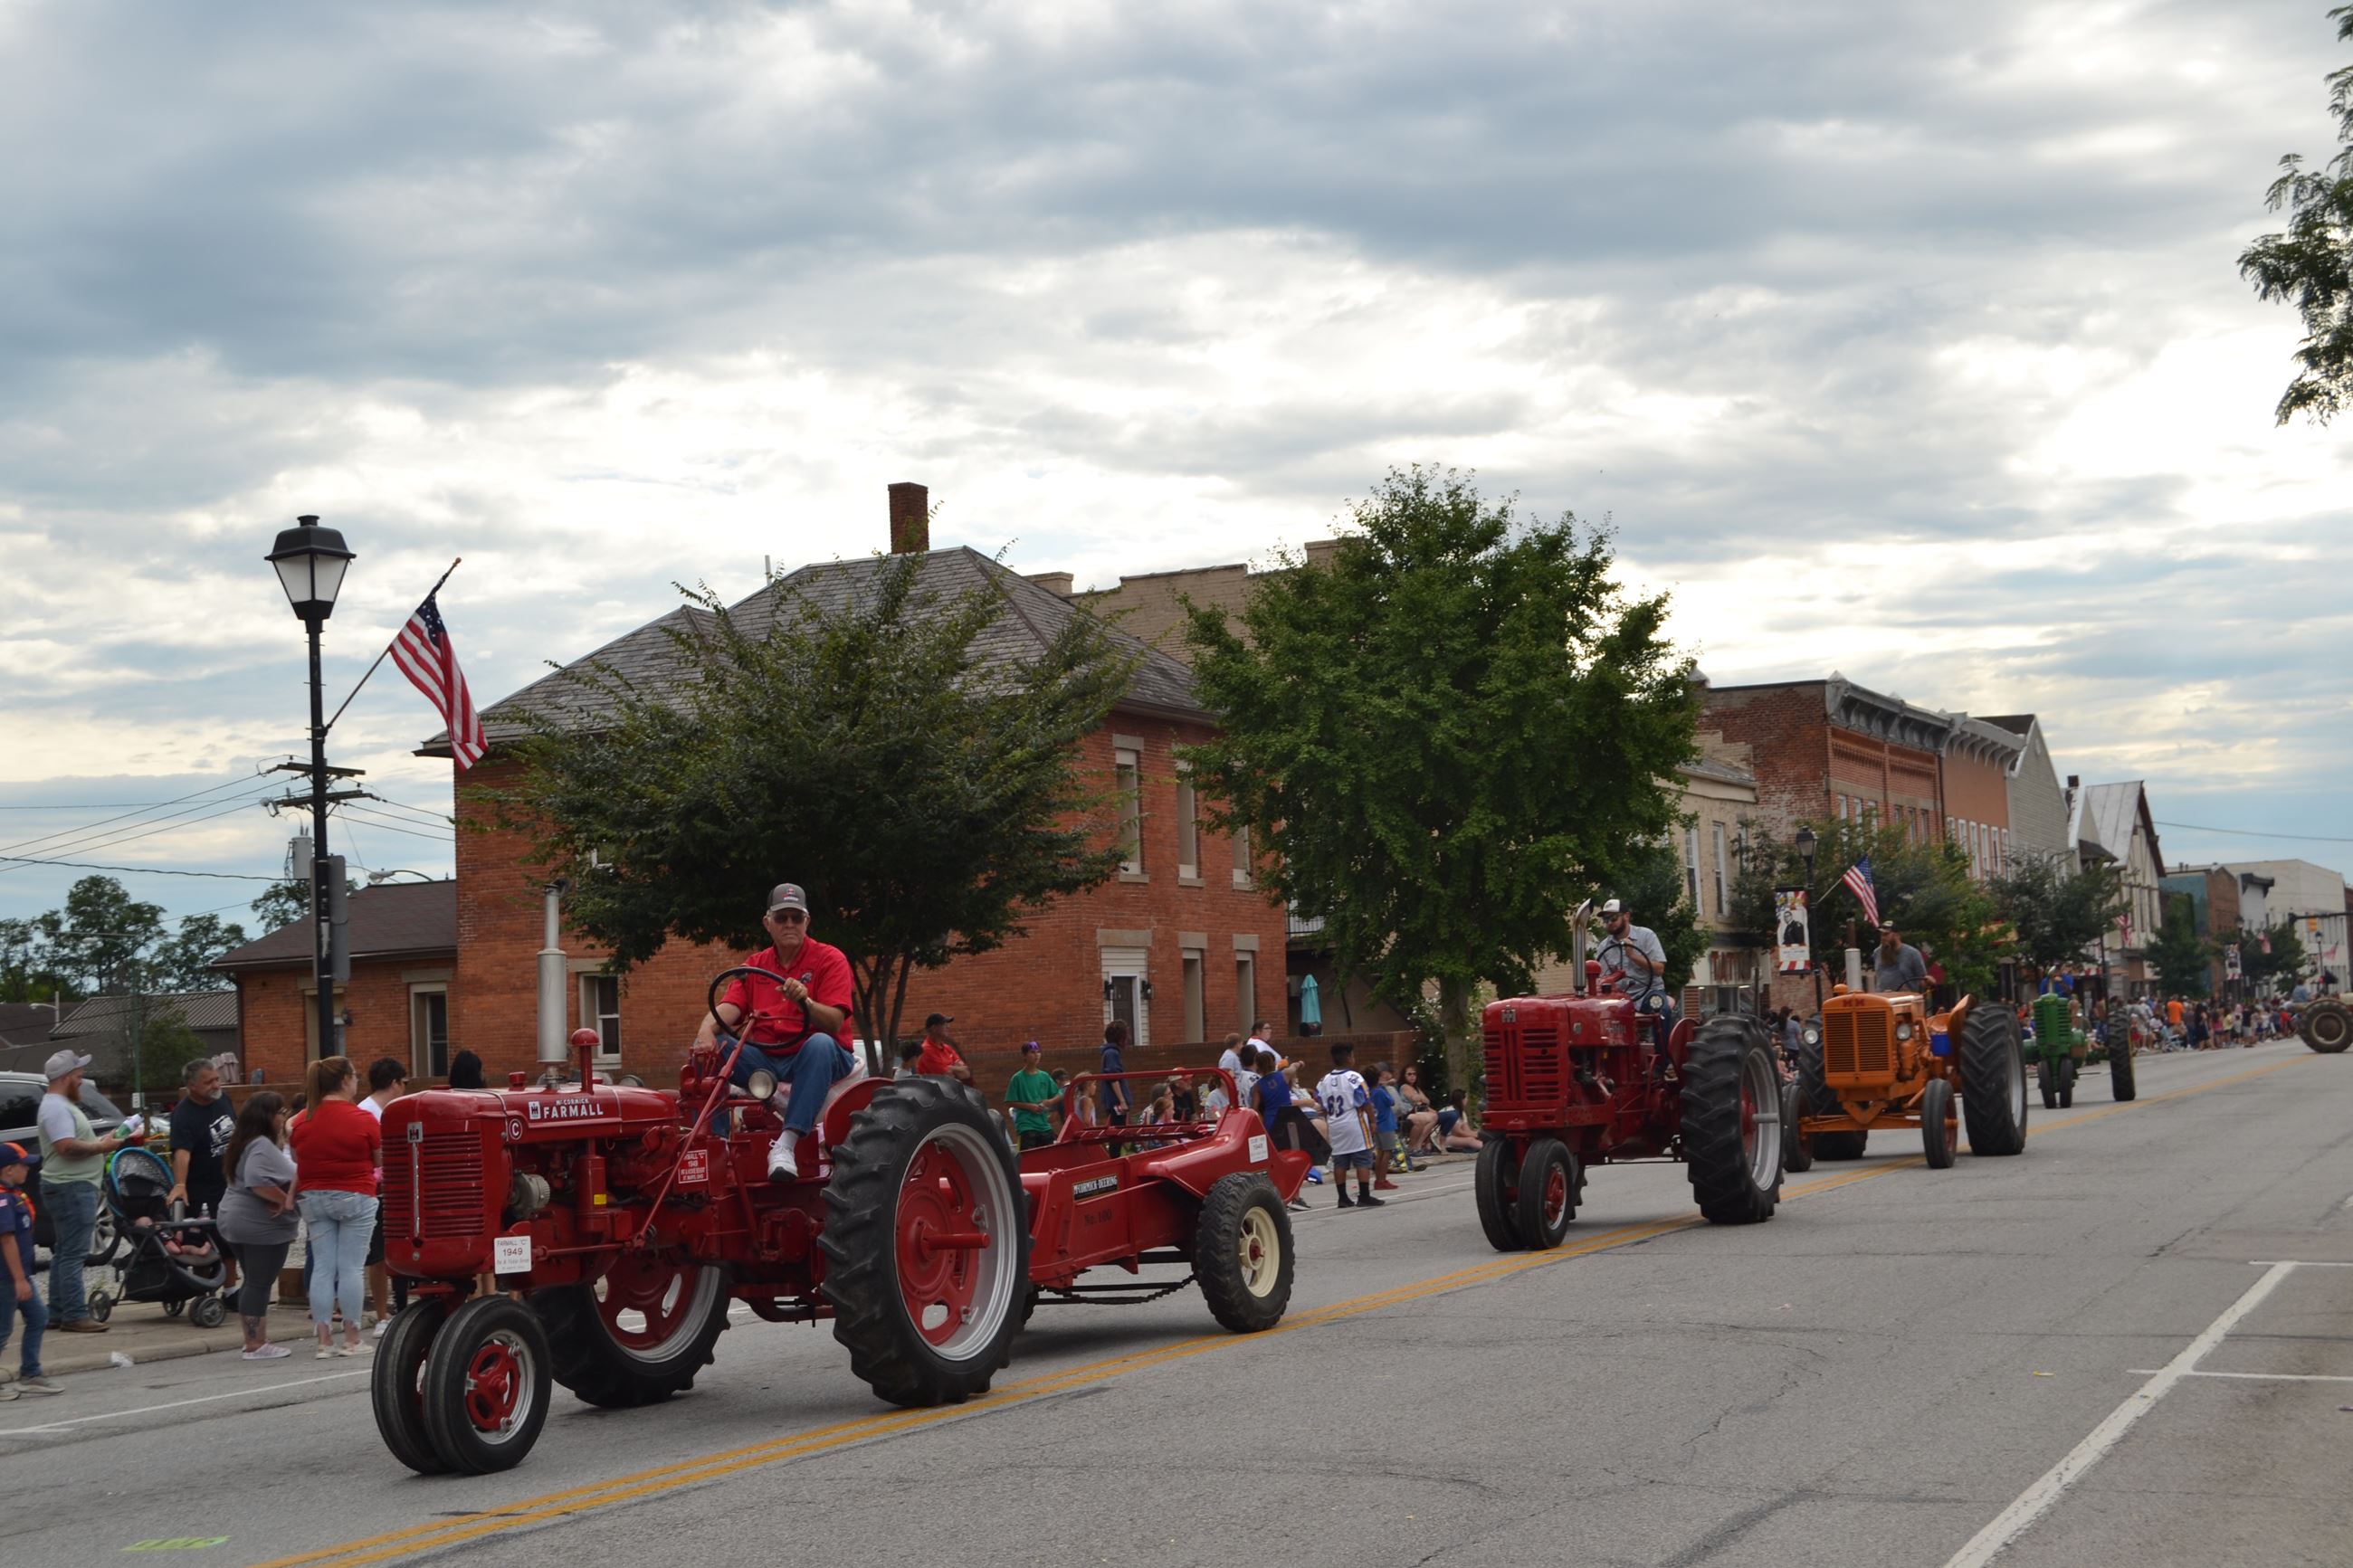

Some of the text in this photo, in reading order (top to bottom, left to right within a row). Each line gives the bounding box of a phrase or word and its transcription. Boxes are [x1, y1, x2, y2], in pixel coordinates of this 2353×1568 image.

[543, 1104, 604, 1119] FARMALL
[511, 1122, 520, 1136] C
[502, 1247, 523, 1257] 1949
